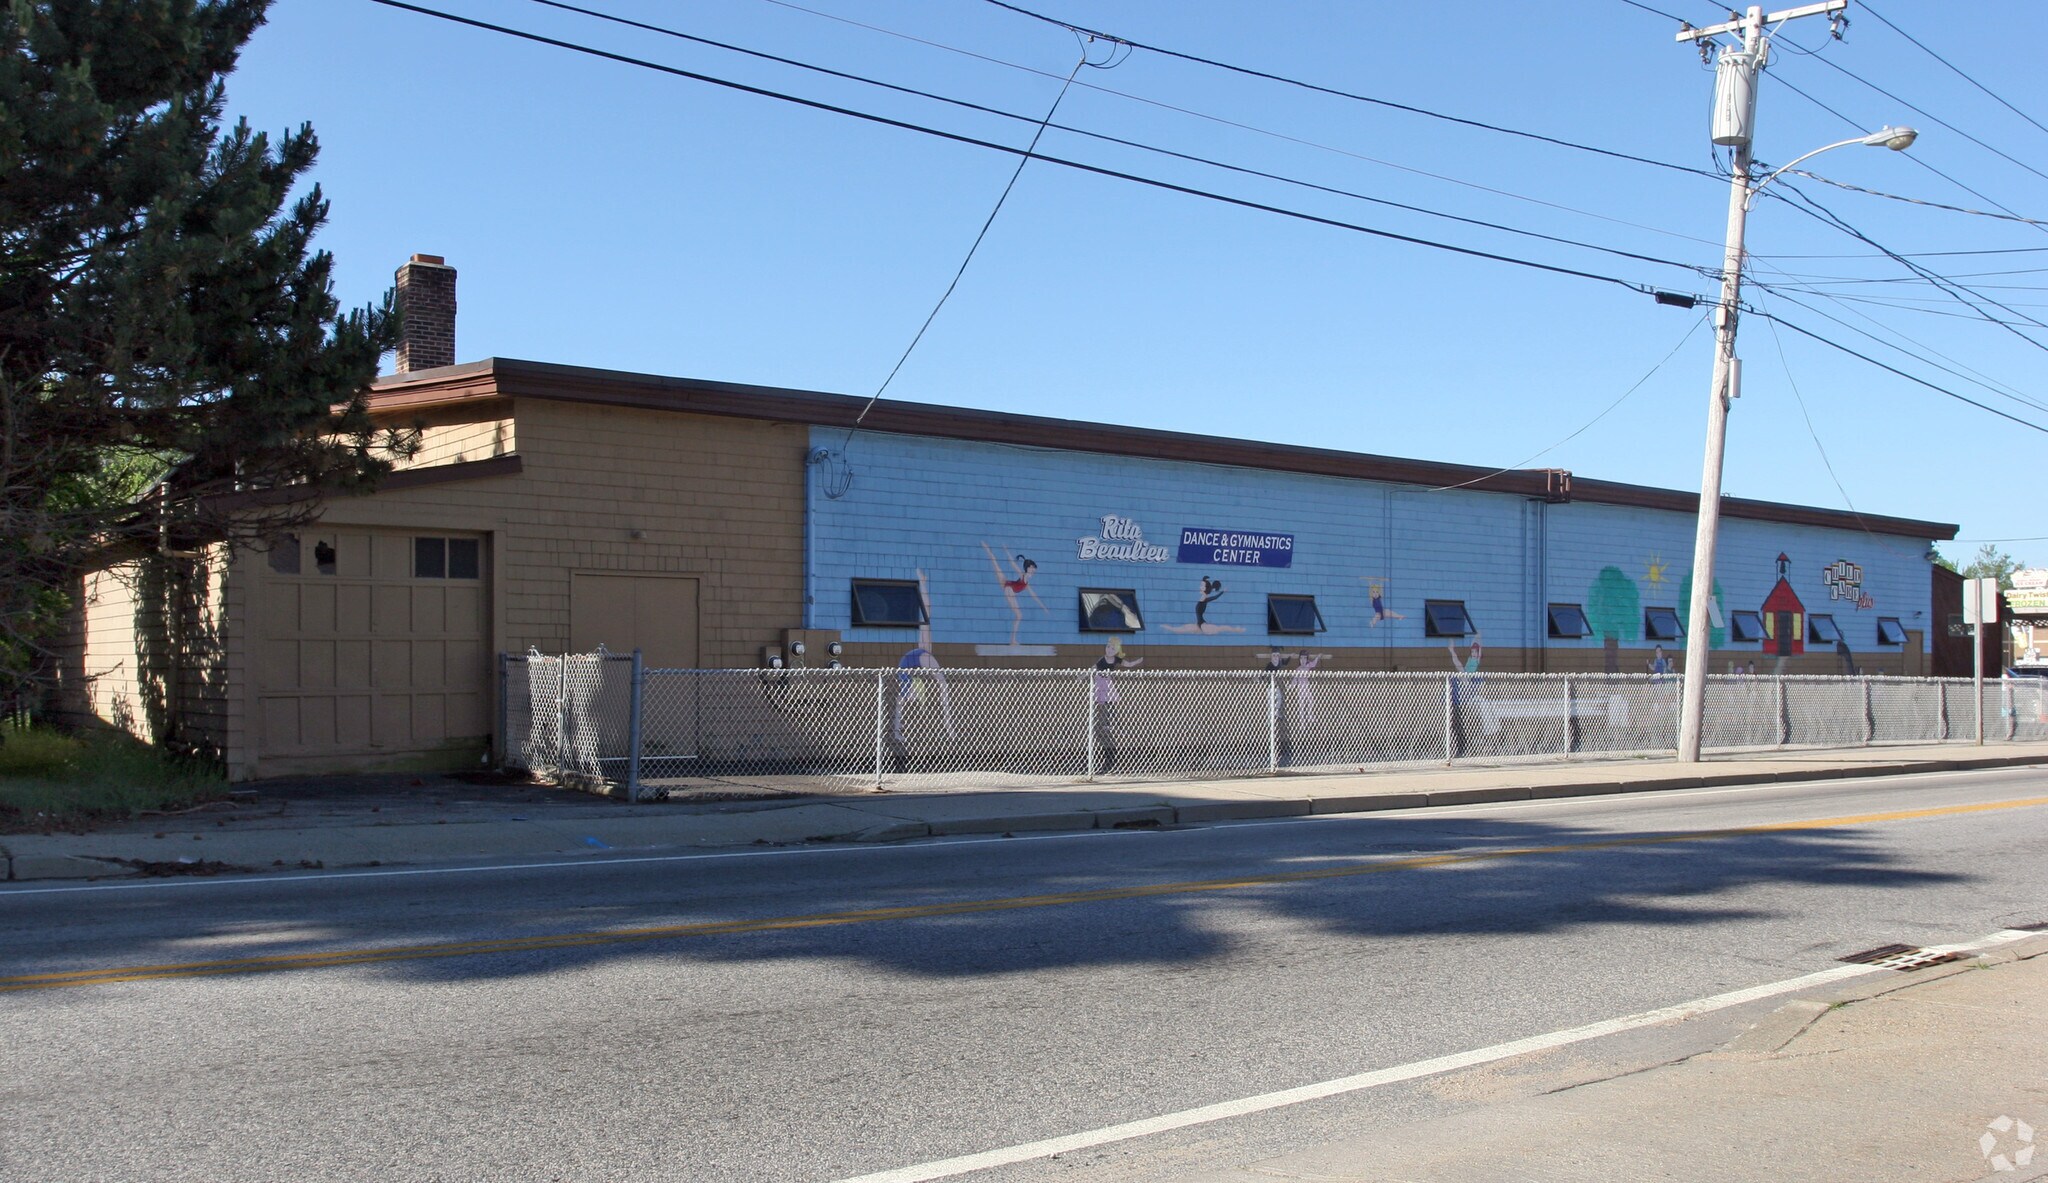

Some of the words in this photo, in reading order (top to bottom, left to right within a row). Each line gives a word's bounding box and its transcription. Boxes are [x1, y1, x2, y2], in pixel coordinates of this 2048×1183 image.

[1101, 514, 1142, 541] Rita
[1077, 536, 1169, 563] Beaulieu
[1183, 531, 1219, 546] DANCE
[1220, 534, 1229, 546] &
[1229, 533, 1292, 550] GYMNASTICS
[1213, 549, 1260, 563] CENTER
[1824, 561, 1861, 585] CHILD
[1831, 580, 1859, 601] CARE
